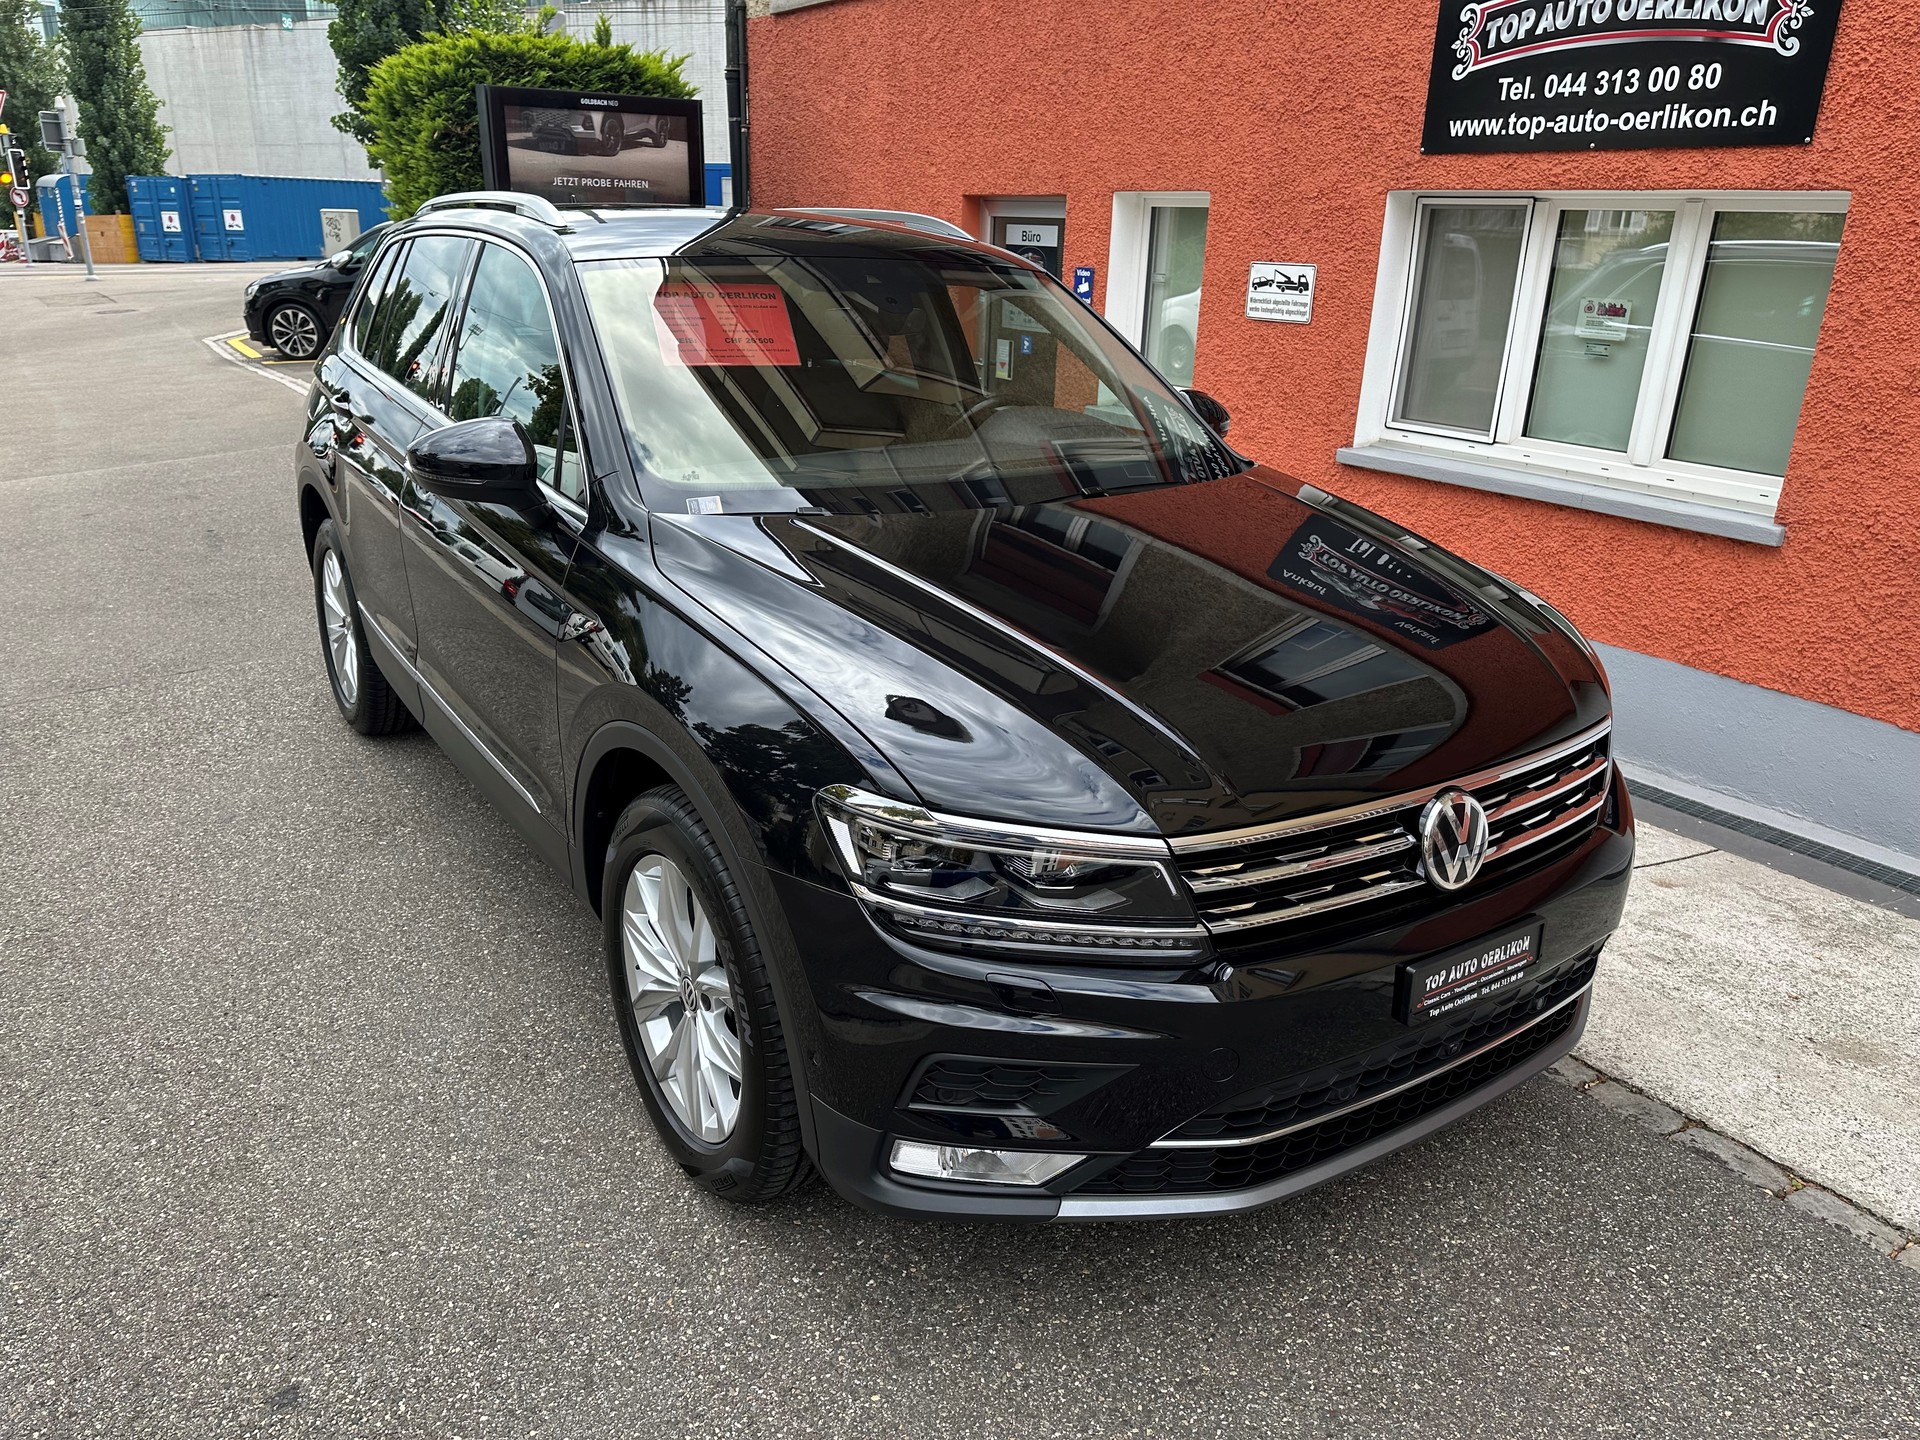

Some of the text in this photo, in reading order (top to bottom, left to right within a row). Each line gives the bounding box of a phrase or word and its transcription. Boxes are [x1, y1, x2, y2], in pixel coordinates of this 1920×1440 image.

[281, 17, 293, 29] 36
[1486, 0, 1770, 49] TOP AUTO OERLIKON
[1498, 62, 1722, 102] Tel. 044 313 00 80
[580, 97, 619, 107] GOLDBACH NEO
[1449, 100, 1777, 140] www.top-auto-oerlikon.ch
[552, 176, 649, 189] JETZT PROBE FAHREN
[1021, 230, 1042, 242] Büro
[1076, 269, 1091, 277] Video
[683, 291, 715, 299] AUTO
[719, 291, 777, 300] OERLIKON
[724, 337, 743, 345] CHF
[1428, 788, 1487, 889] VW
[1425, 935, 1530, 991] TOP AUTO OERLIKON
[1423, 995, 1440, 1006] Classic
[1440, 991, 1451, 999] Cars
[1453, 979, 1478, 993] Youngtimer
[1429, 1008, 1440, 1017] Top
[1441, 1001, 1454, 1012] Auto
[1454, 992, 1478, 1007] Oerlikon
[1481, 986, 1490, 995] Tel.
[1500, 978, 1510, 987] 313
